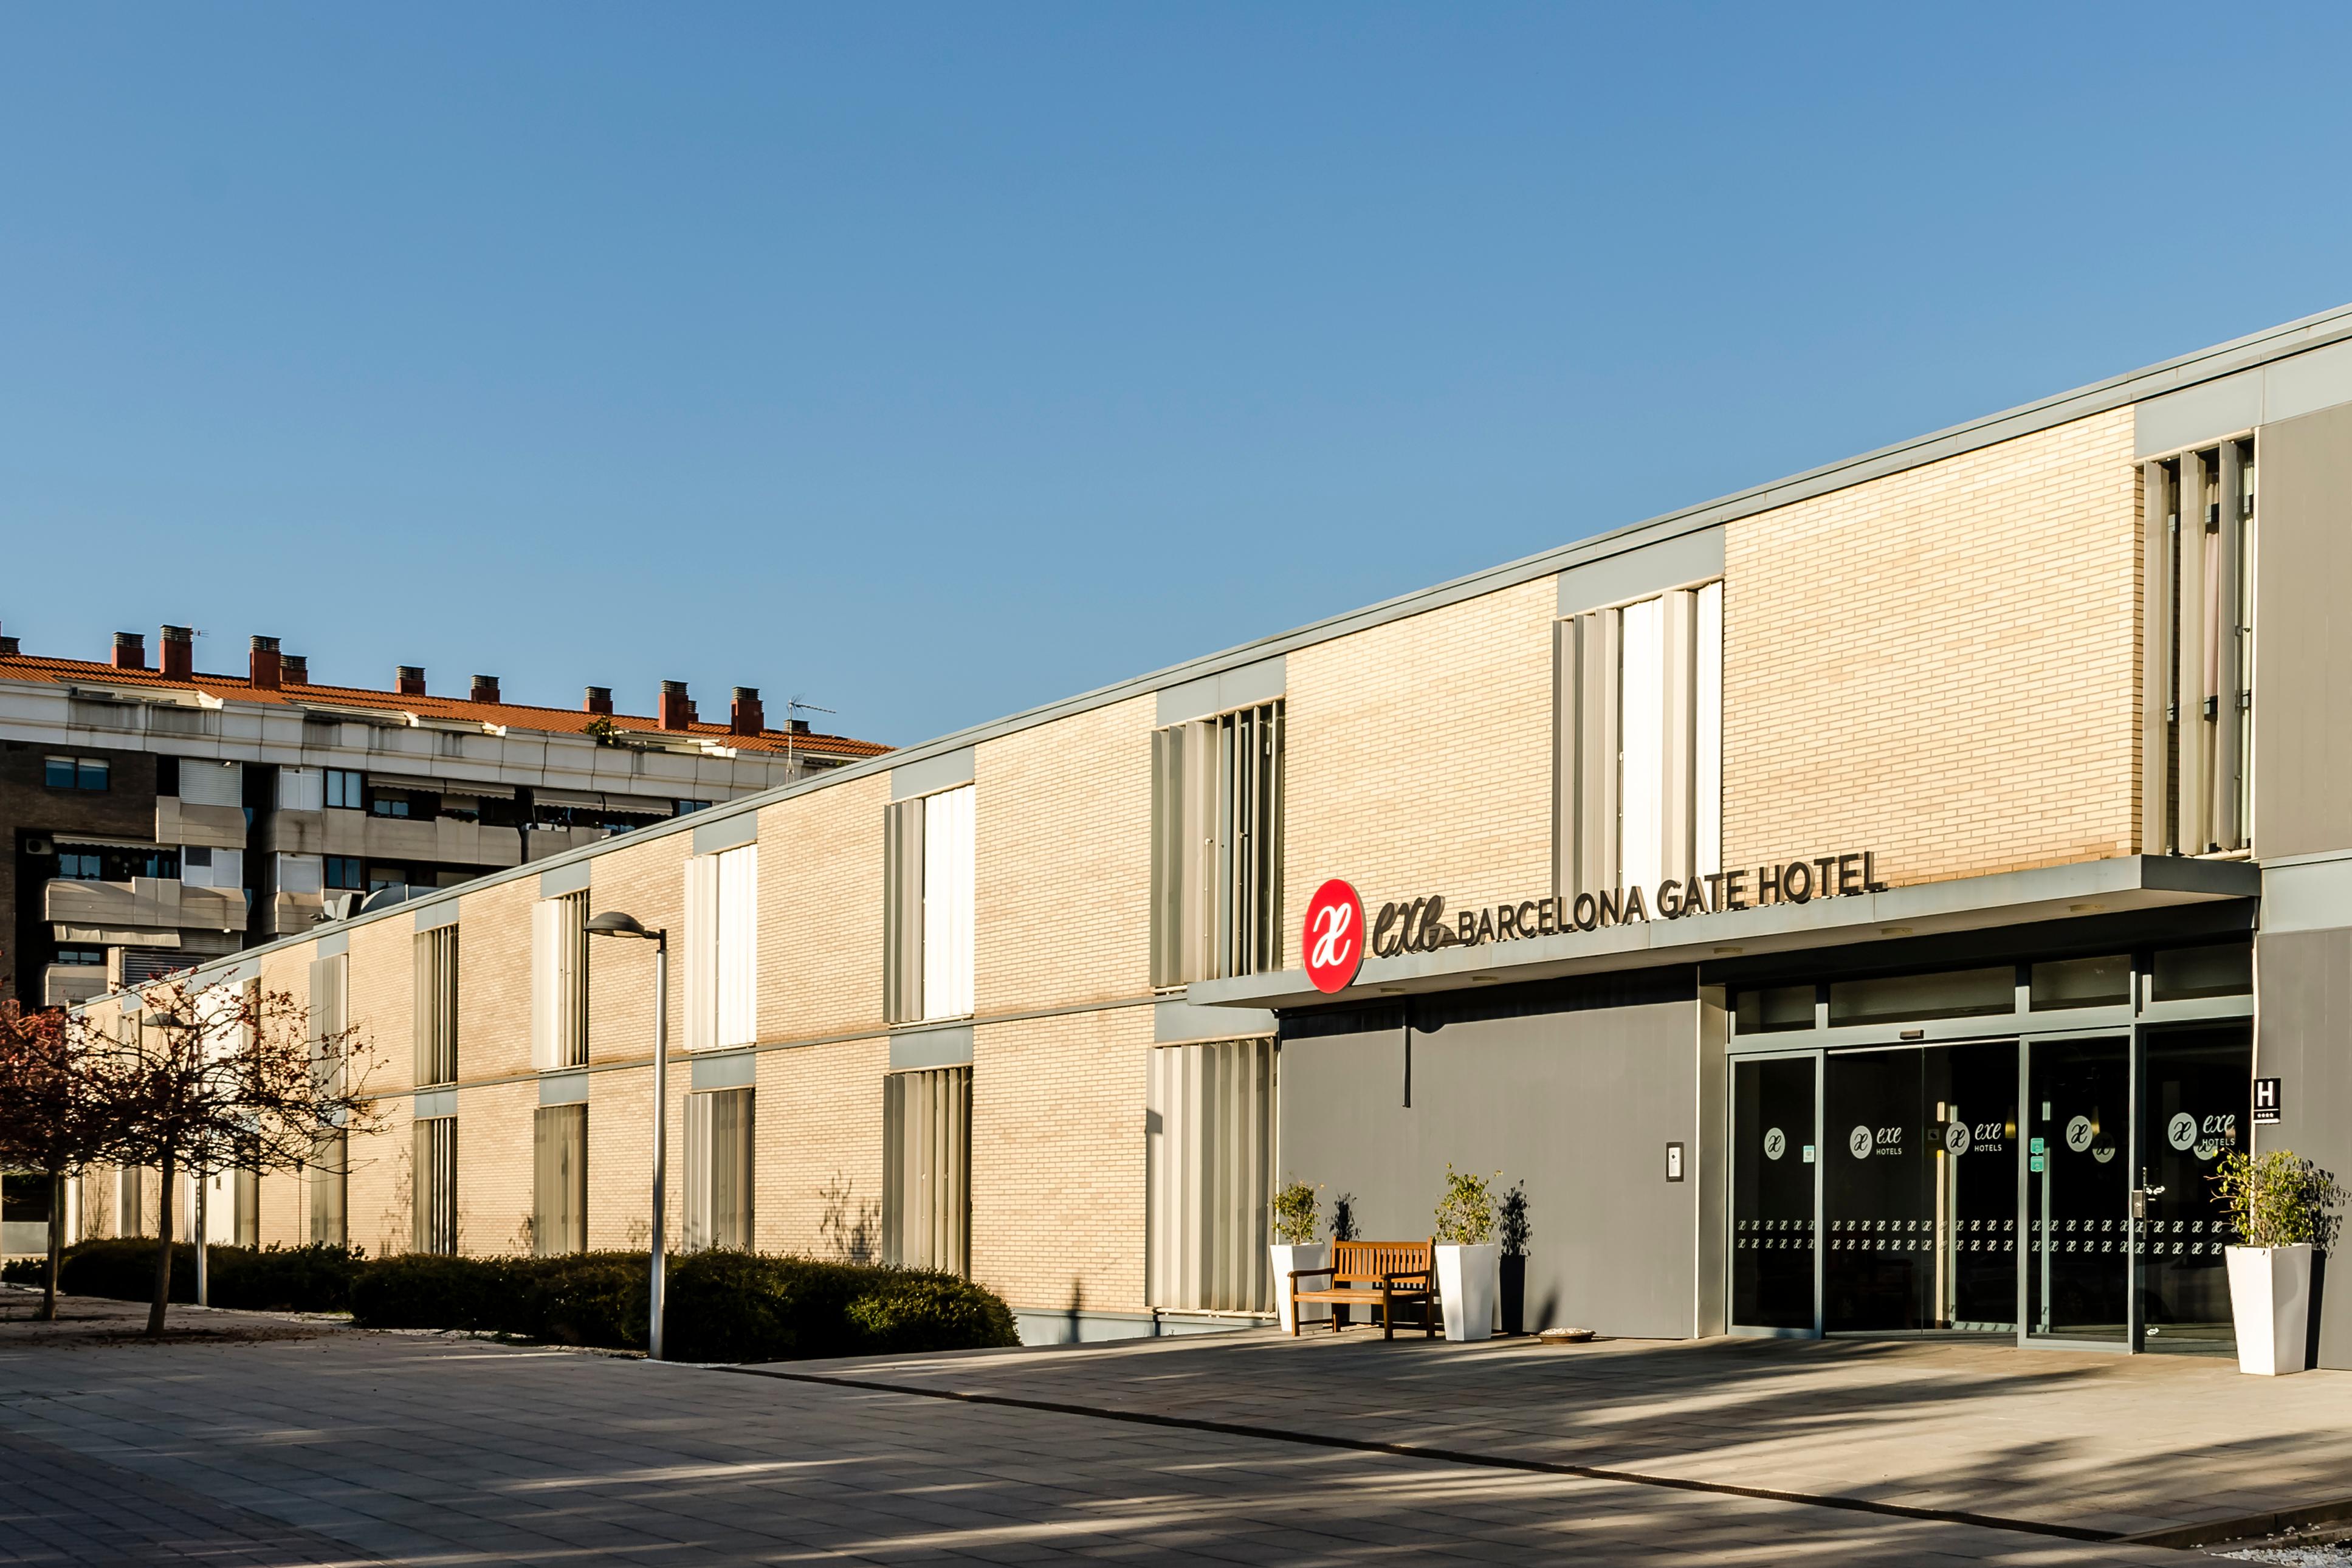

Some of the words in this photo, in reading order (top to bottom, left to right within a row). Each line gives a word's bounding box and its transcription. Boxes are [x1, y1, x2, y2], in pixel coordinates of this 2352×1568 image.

[1372, 895, 1445, 958] exe
[1459, 885, 1650, 947] BARCELONA
[1657, 870, 1749, 920] GATE
[1759, 851, 1888, 904] HOTEL
[2257, 1081, 2274, 1107] H
[1975, 1123, 2001, 1140] exe
[2202, 1114, 2235, 1133] exe
[1876, 1127, 1902, 1144] exe
[2202, 1138, 2235, 1147] HOTELS
[1974, 1144, 2002, 1152] HOTELS
